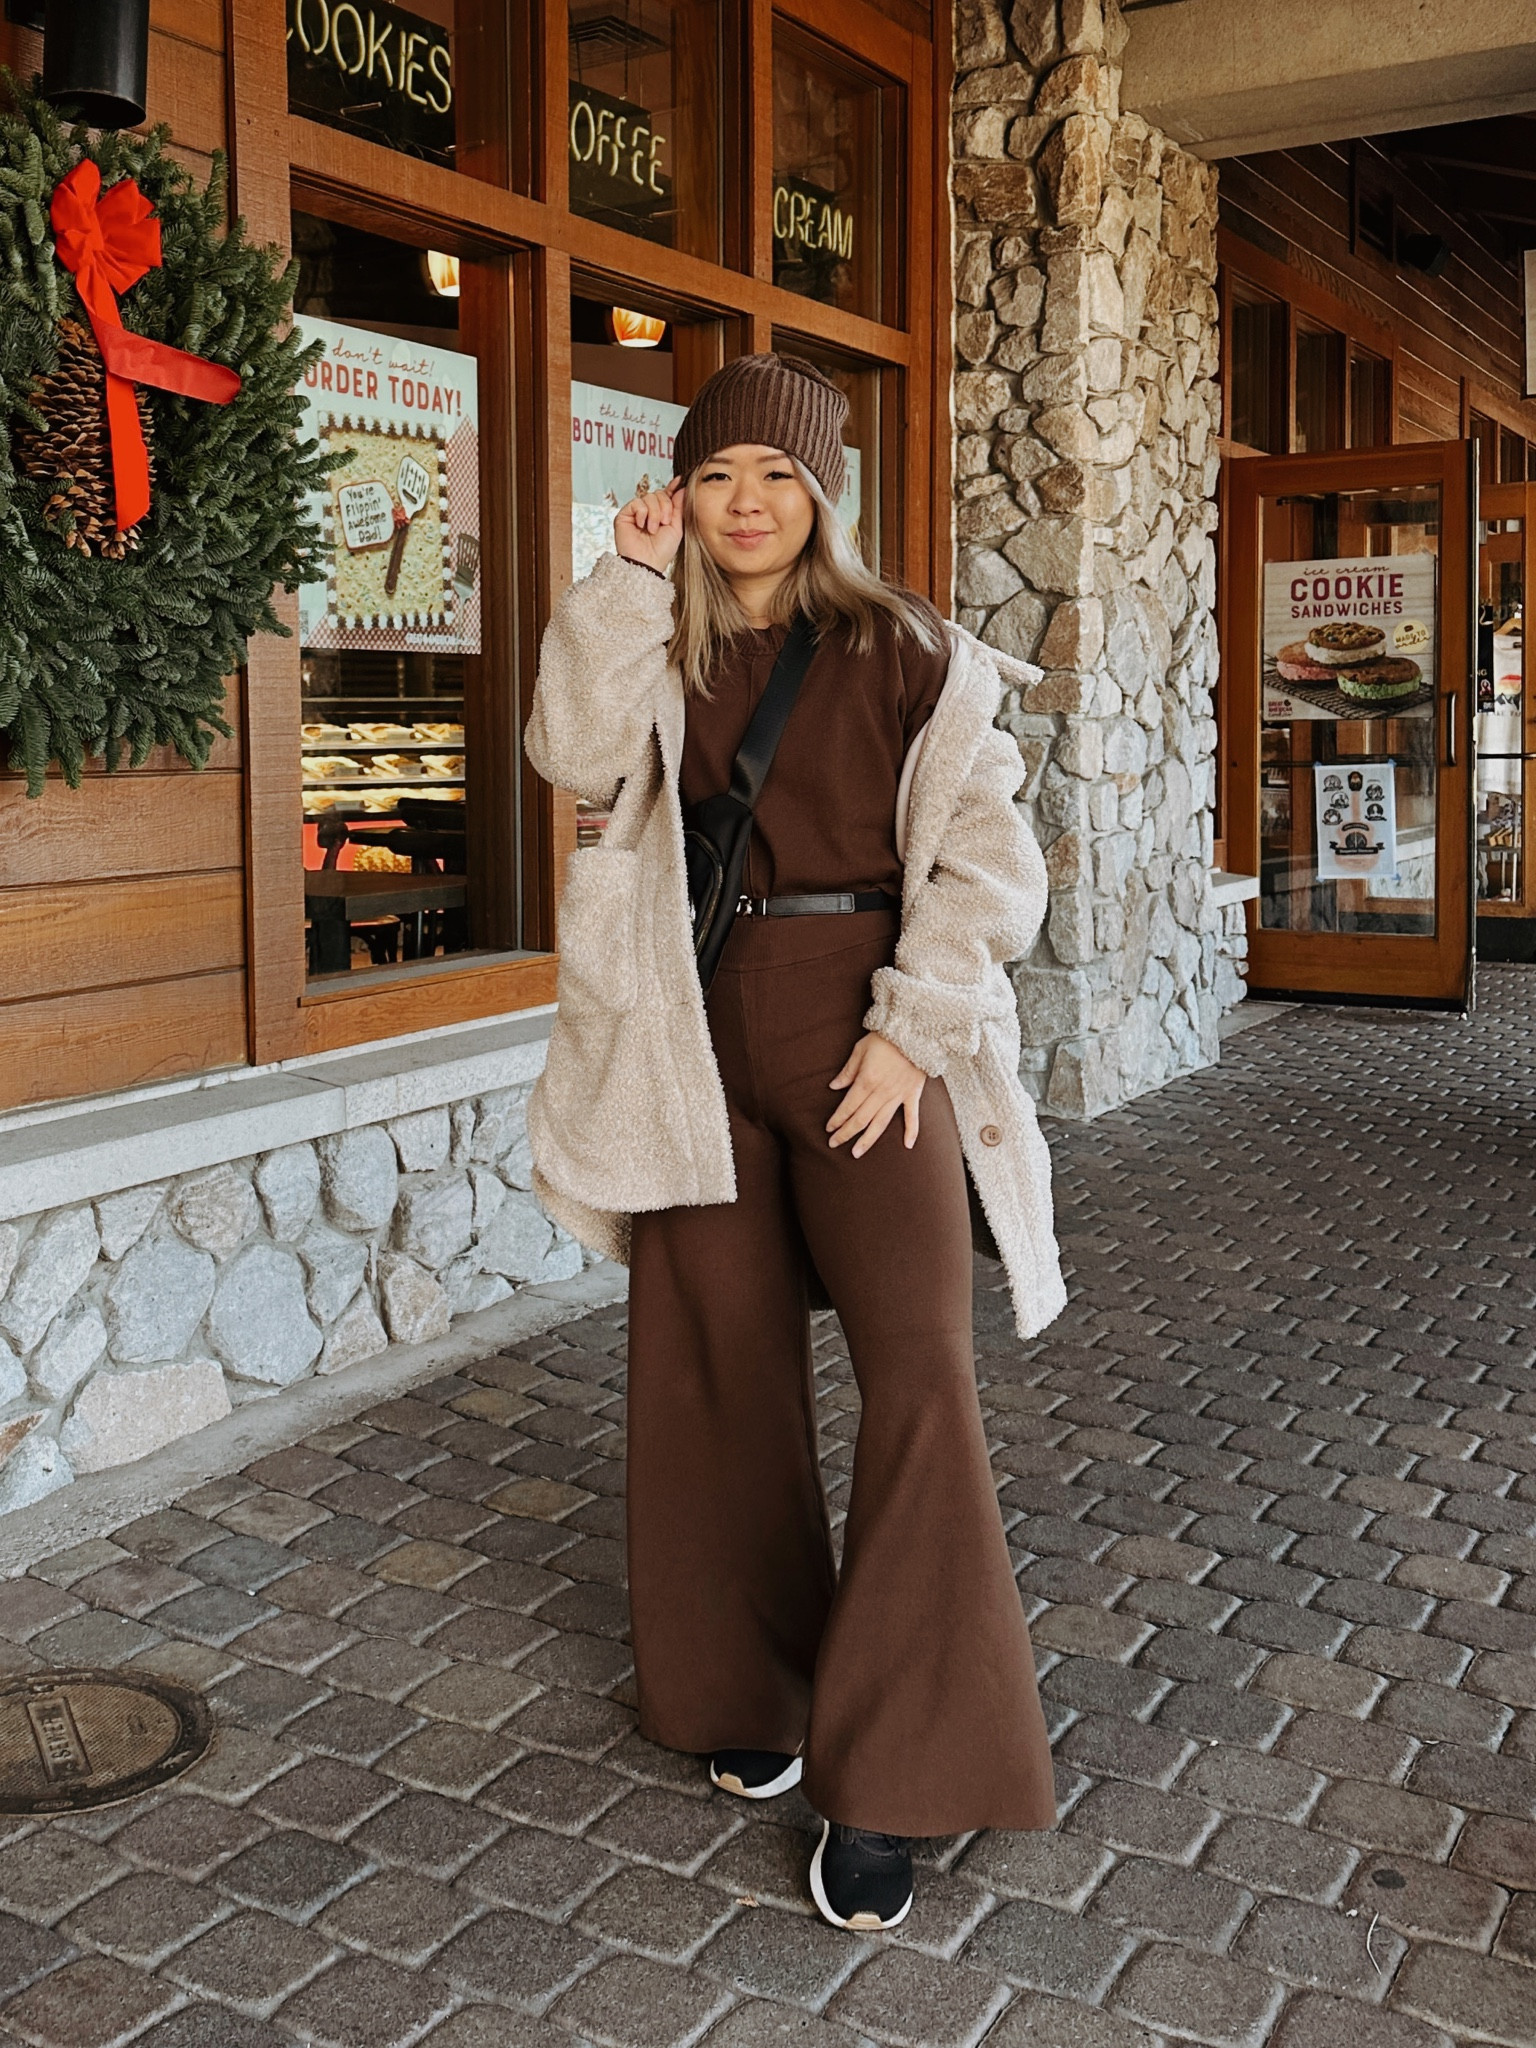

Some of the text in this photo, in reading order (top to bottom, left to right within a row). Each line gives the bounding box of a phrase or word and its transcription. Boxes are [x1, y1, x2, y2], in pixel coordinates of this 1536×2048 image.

[286, 0, 452, 113] OOKIES
[569, 101, 666, 195] OFFEE
[774, 186, 853, 260] CREAM
[332, 337, 435, 378] don't wait!
[304, 361, 462, 417] ORDER TODAY!
[599, 403, 619, 419] the
[622, 406, 646, 425] best
[573, 416, 675, 460] BOTH WORLD
[347, 486, 375, 501] You're
[358, 525, 382, 543] Dad!
[1303, 564, 1389, 576] ice cream
[1290, 573, 1404, 603] COOKIE
[1291, 601, 1404, 619] SANDWICHES
